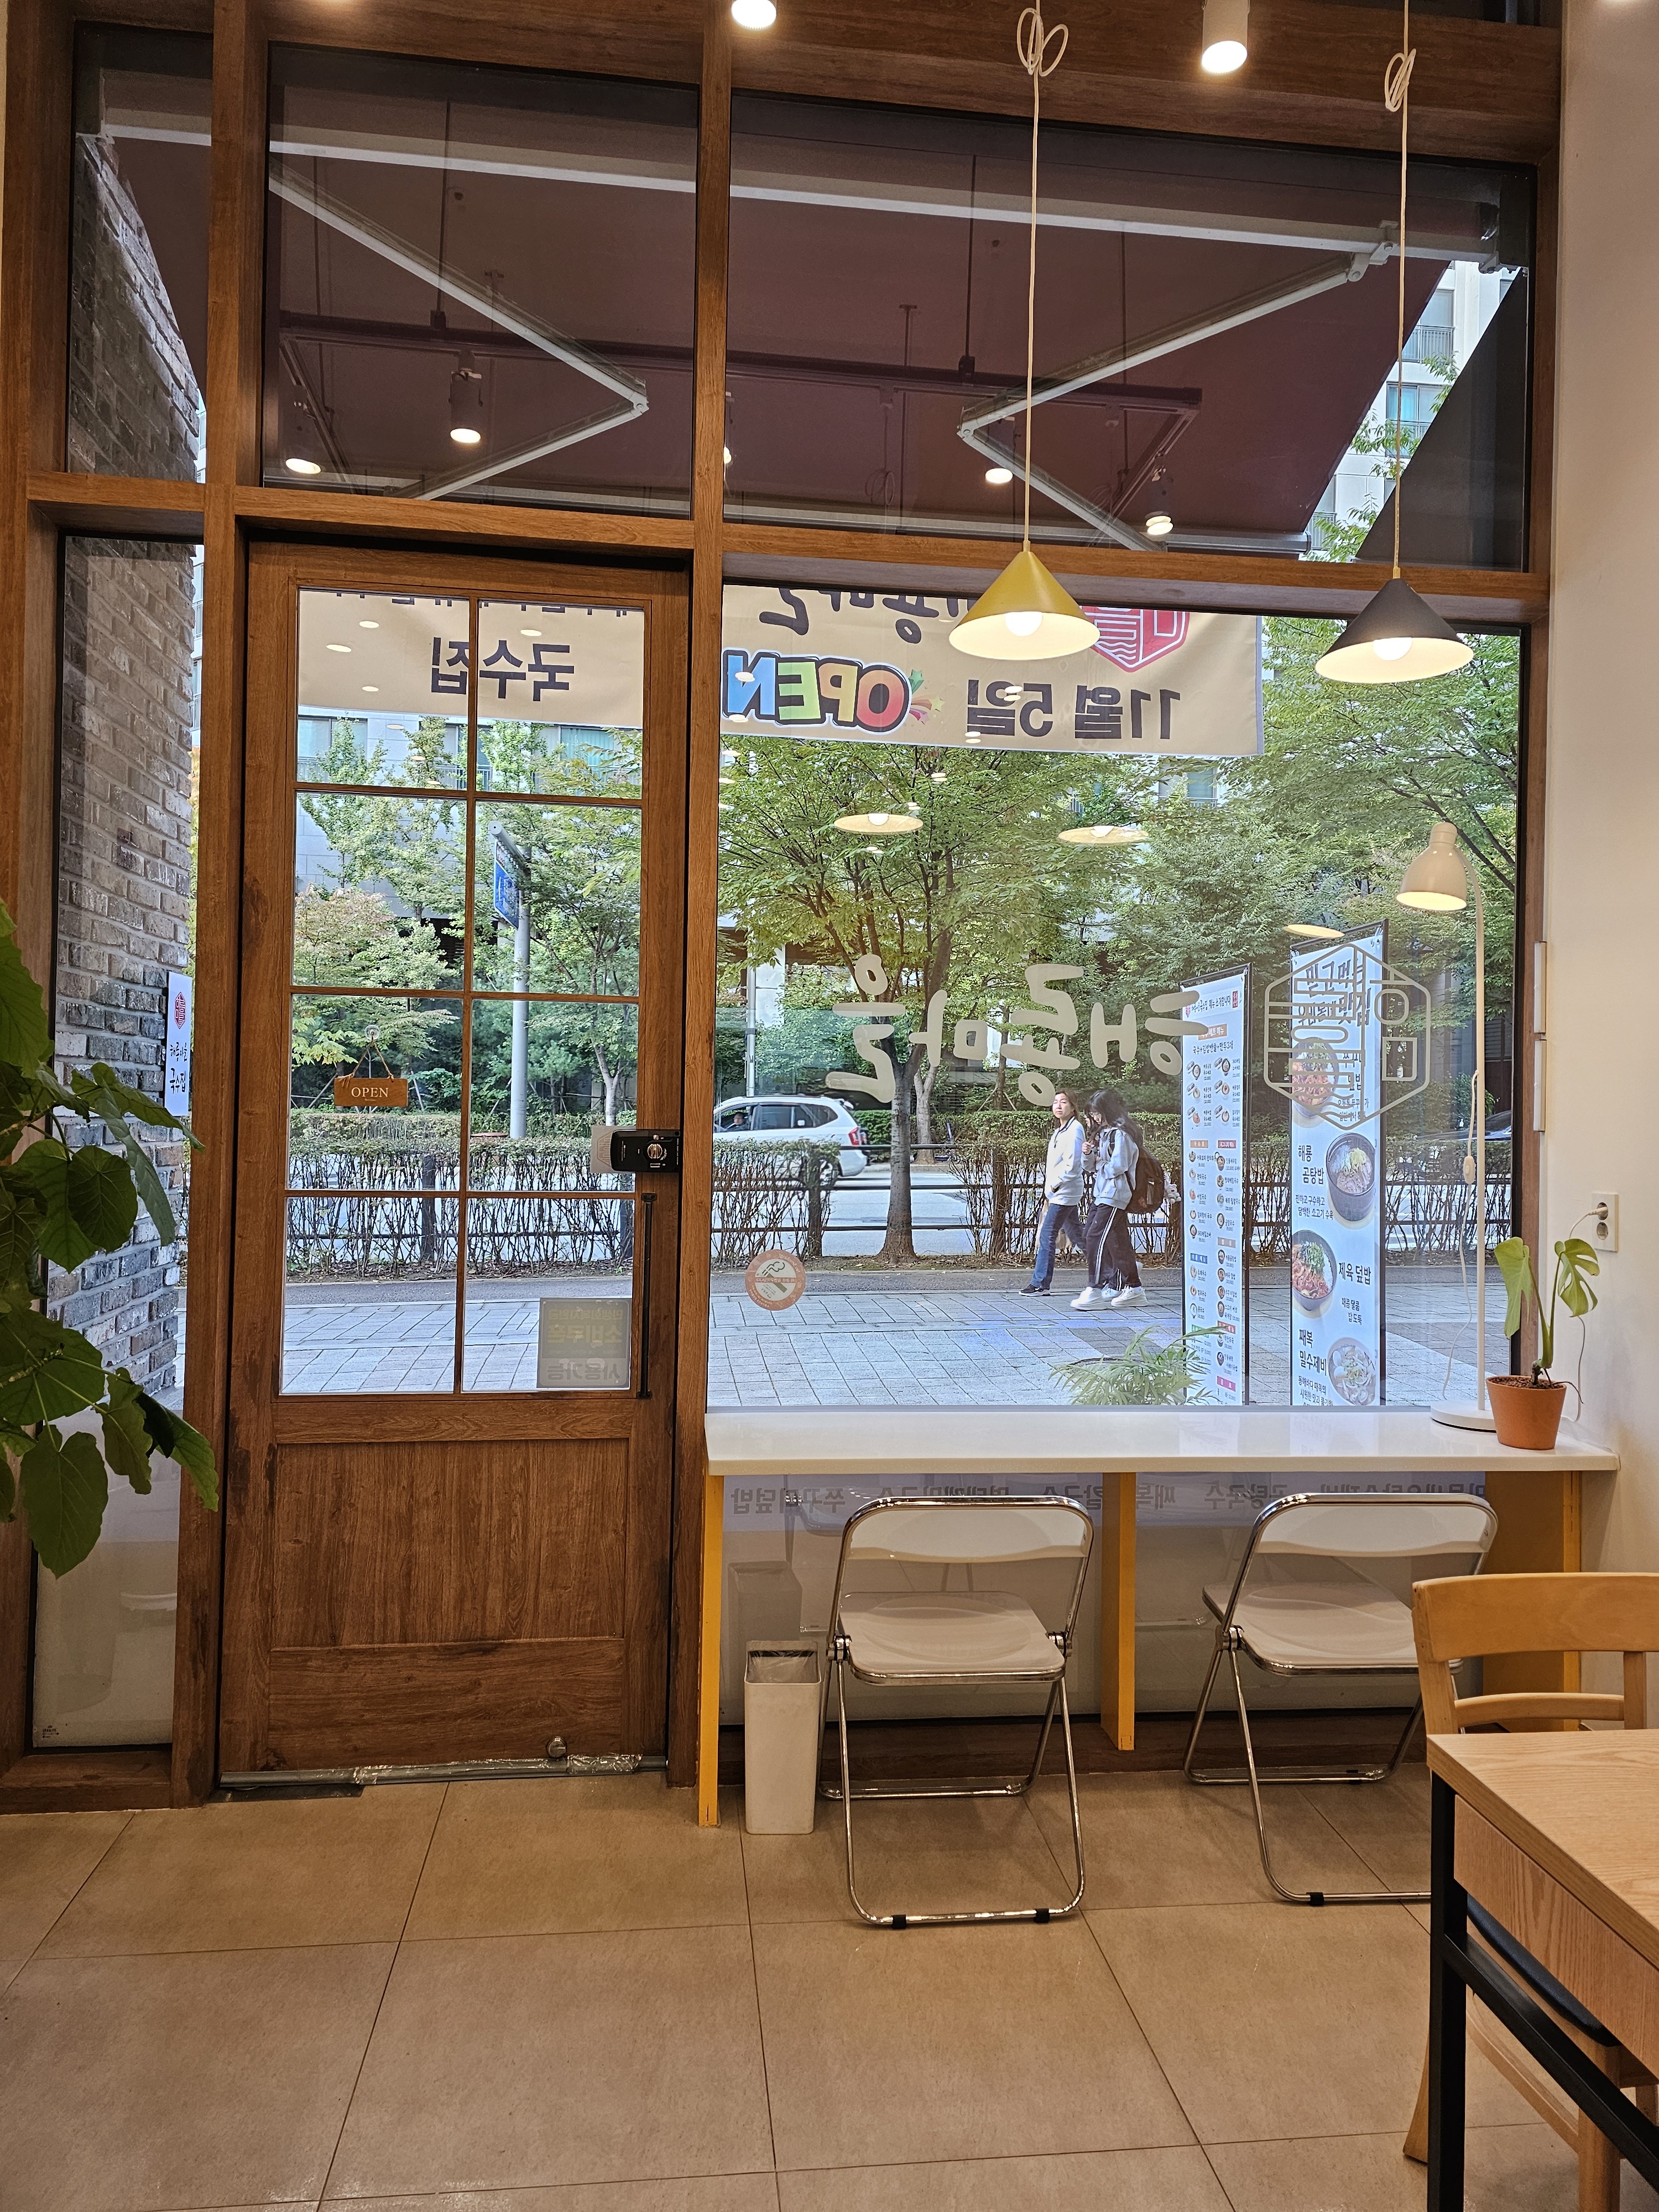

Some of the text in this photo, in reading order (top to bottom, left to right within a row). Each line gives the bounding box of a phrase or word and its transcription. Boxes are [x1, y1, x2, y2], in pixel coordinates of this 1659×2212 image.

[170, 1068, 186, 1094] 국수집
[351, 1087, 389, 1098] OPEN
[1298, 1145, 1312, 1162] 해룡
[1303, 1167, 1324, 1185] 곰탕밥
[1308, 1196, 1325, 1206] 구수하고
[1312, 1209, 1324, 1219] 소고기
[1326, 1210, 1334, 1220] 수육
[1339, 1262, 1371, 1285] 제육 덮밥
[1300, 1329, 1313, 1348] 째복
[1300, 1351, 1326, 1376] 밀수제비
